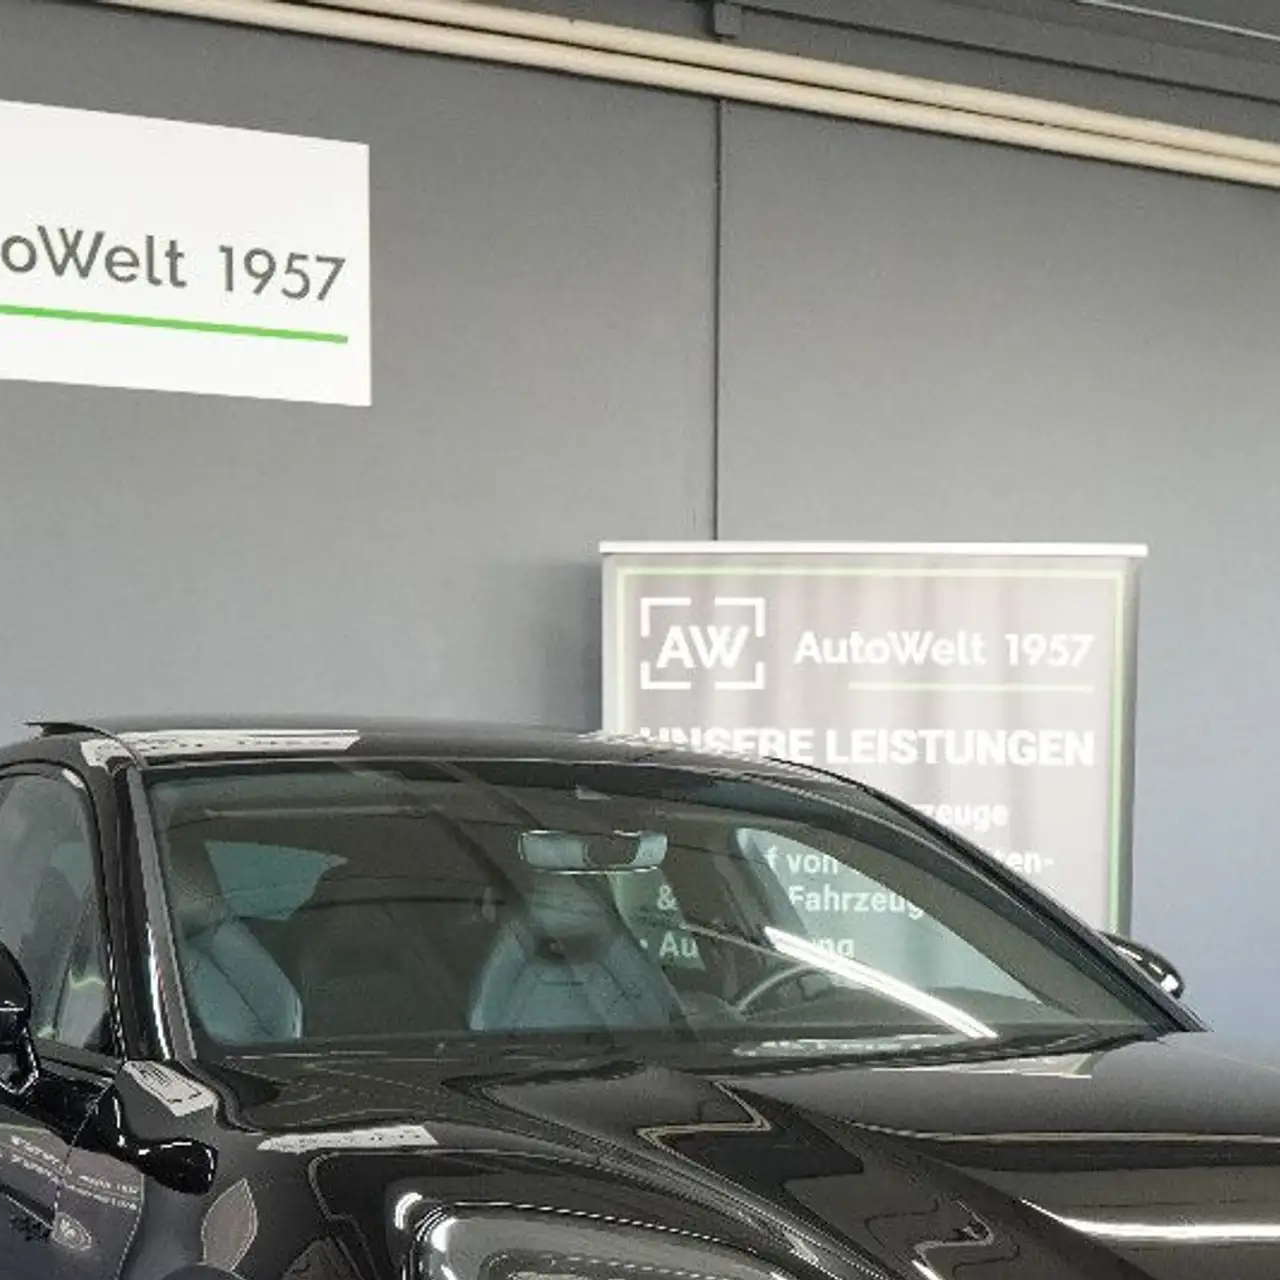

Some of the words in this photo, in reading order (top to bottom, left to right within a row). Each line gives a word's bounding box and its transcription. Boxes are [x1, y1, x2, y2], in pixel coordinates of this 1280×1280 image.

[218, 245, 347, 302] 1957
[655, 624, 749, 669] AW
[793, 630, 986, 668] AutoWelt
[1004, 633, 1095, 669] 1957
[826, 729, 1095, 767] LEISTUNGEN
[657, 884, 679, 911] &
